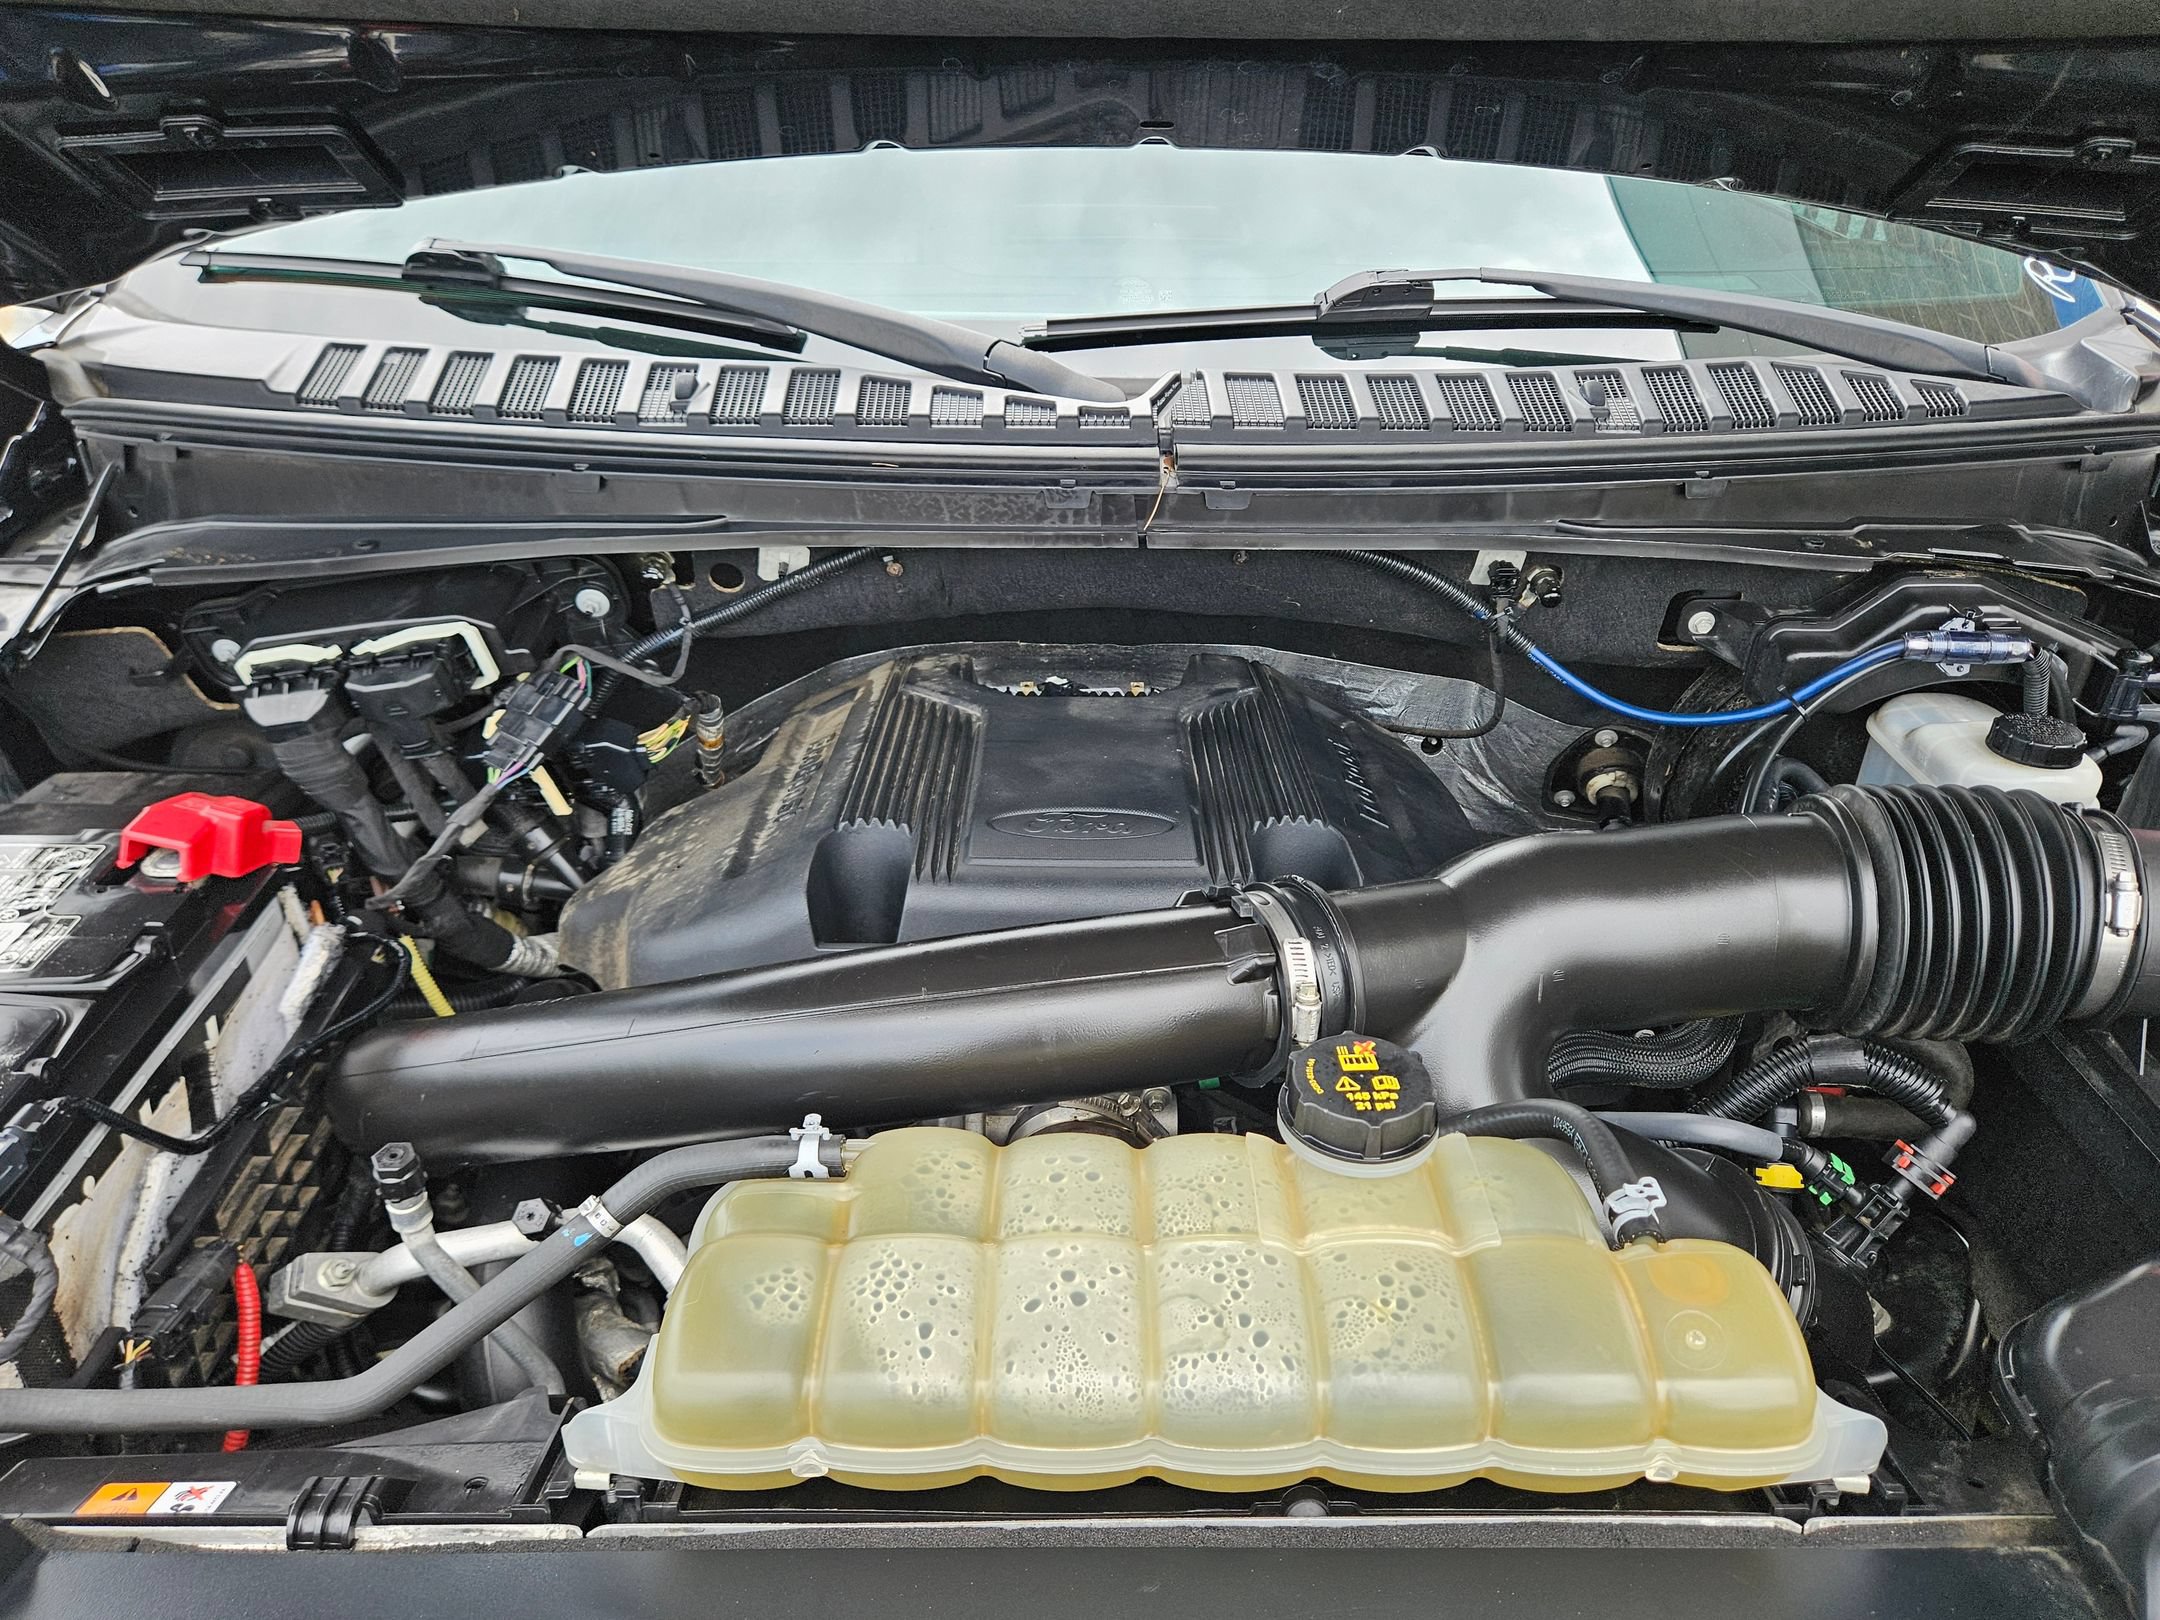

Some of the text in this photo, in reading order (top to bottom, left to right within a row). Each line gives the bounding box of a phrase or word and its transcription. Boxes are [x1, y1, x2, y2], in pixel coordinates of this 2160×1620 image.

[1024, 812, 1132, 834] Ford
[1373, 1091, 1399, 1100] kPa
[1356, 1100, 1397, 1112] 21 psi
